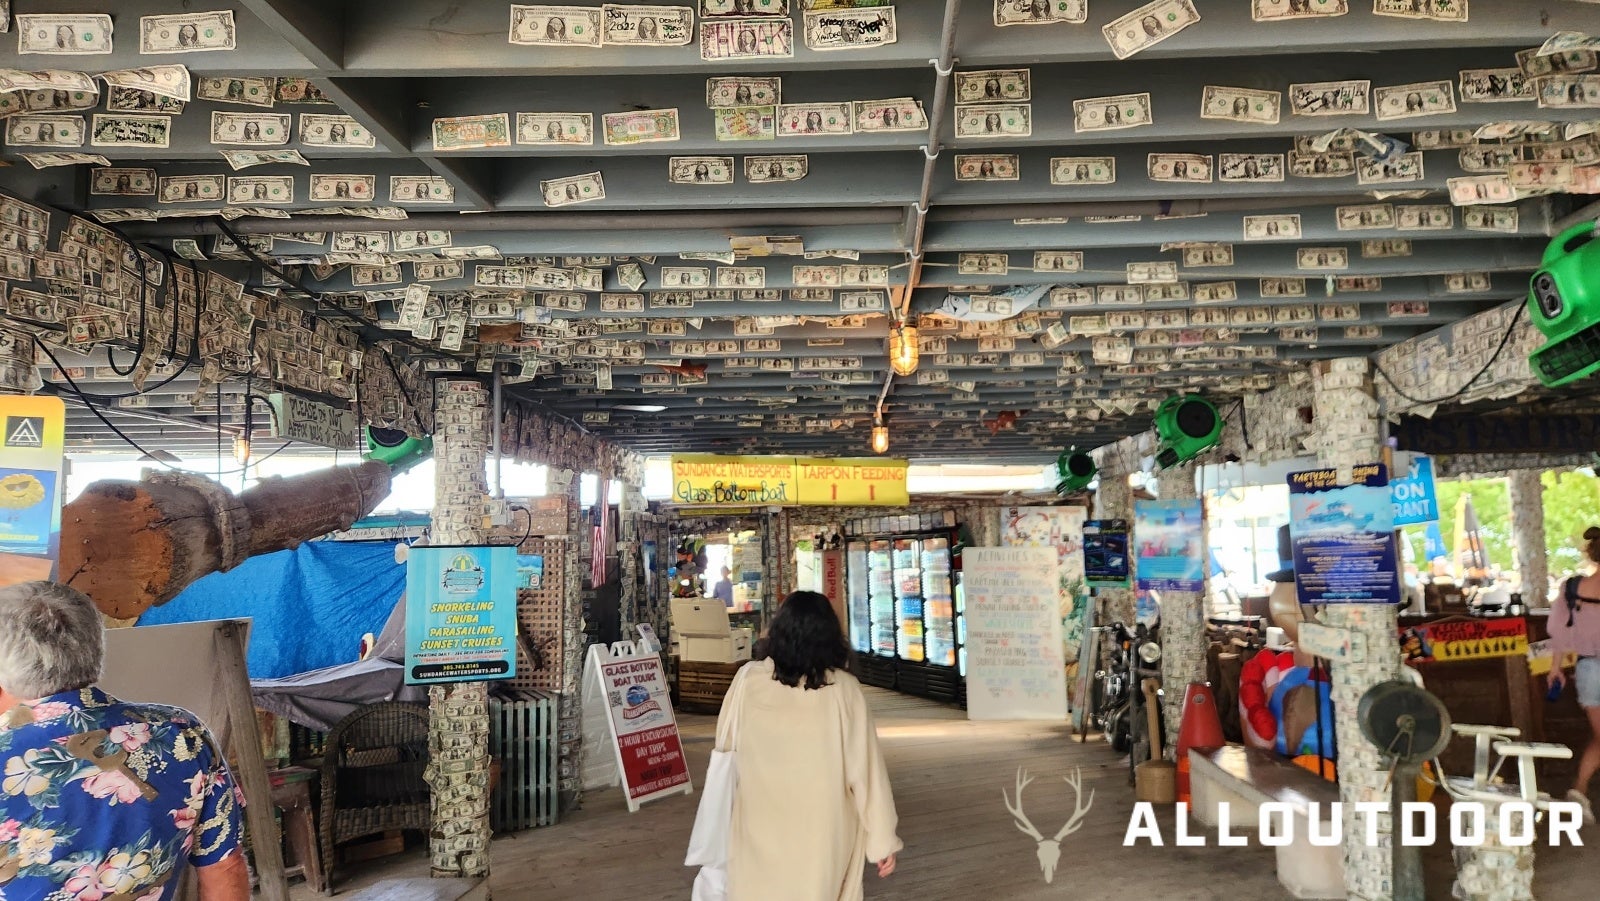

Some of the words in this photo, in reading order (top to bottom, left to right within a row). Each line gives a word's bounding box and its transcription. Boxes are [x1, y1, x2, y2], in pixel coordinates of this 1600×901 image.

[609, 22, 636, 31] 2022
[289, 397, 318, 420] PLEASE
[329, 409, 343, 430] NOT
[676, 461, 727, 477] SUNDANCE
[729, 461, 792, 479] WATERSPORTS
[800, 463, 850, 480] TARPON
[853, 465, 904, 481] FEEDING
[677, 480, 713, 503] Glass
[714, 480, 757, 503] Bottom
[760, 480, 788, 502] Boat
[977, 550, 1028, 562] ACTIVITIES
[827, 558, 836, 578] Bull
[827, 579, 836, 599] Red
[430, 601, 495, 613] SNORKELING
[446, 614, 479, 624] SNUBA
[429, 625, 495, 637] PARASAILING
[420, 639, 460, 650] SUNSET
[461, 637, 503, 648] CRUISES
[606, 665, 629, 676] GLASS
[630, 662, 658, 673] BOTTOM
[613, 676, 631, 687] BOAT
[633, 673, 656, 683] TOURS
[624, 735, 641, 747] HOUR
[636, 746, 648, 759] DAY
[649, 742, 667, 754] TRIPS
